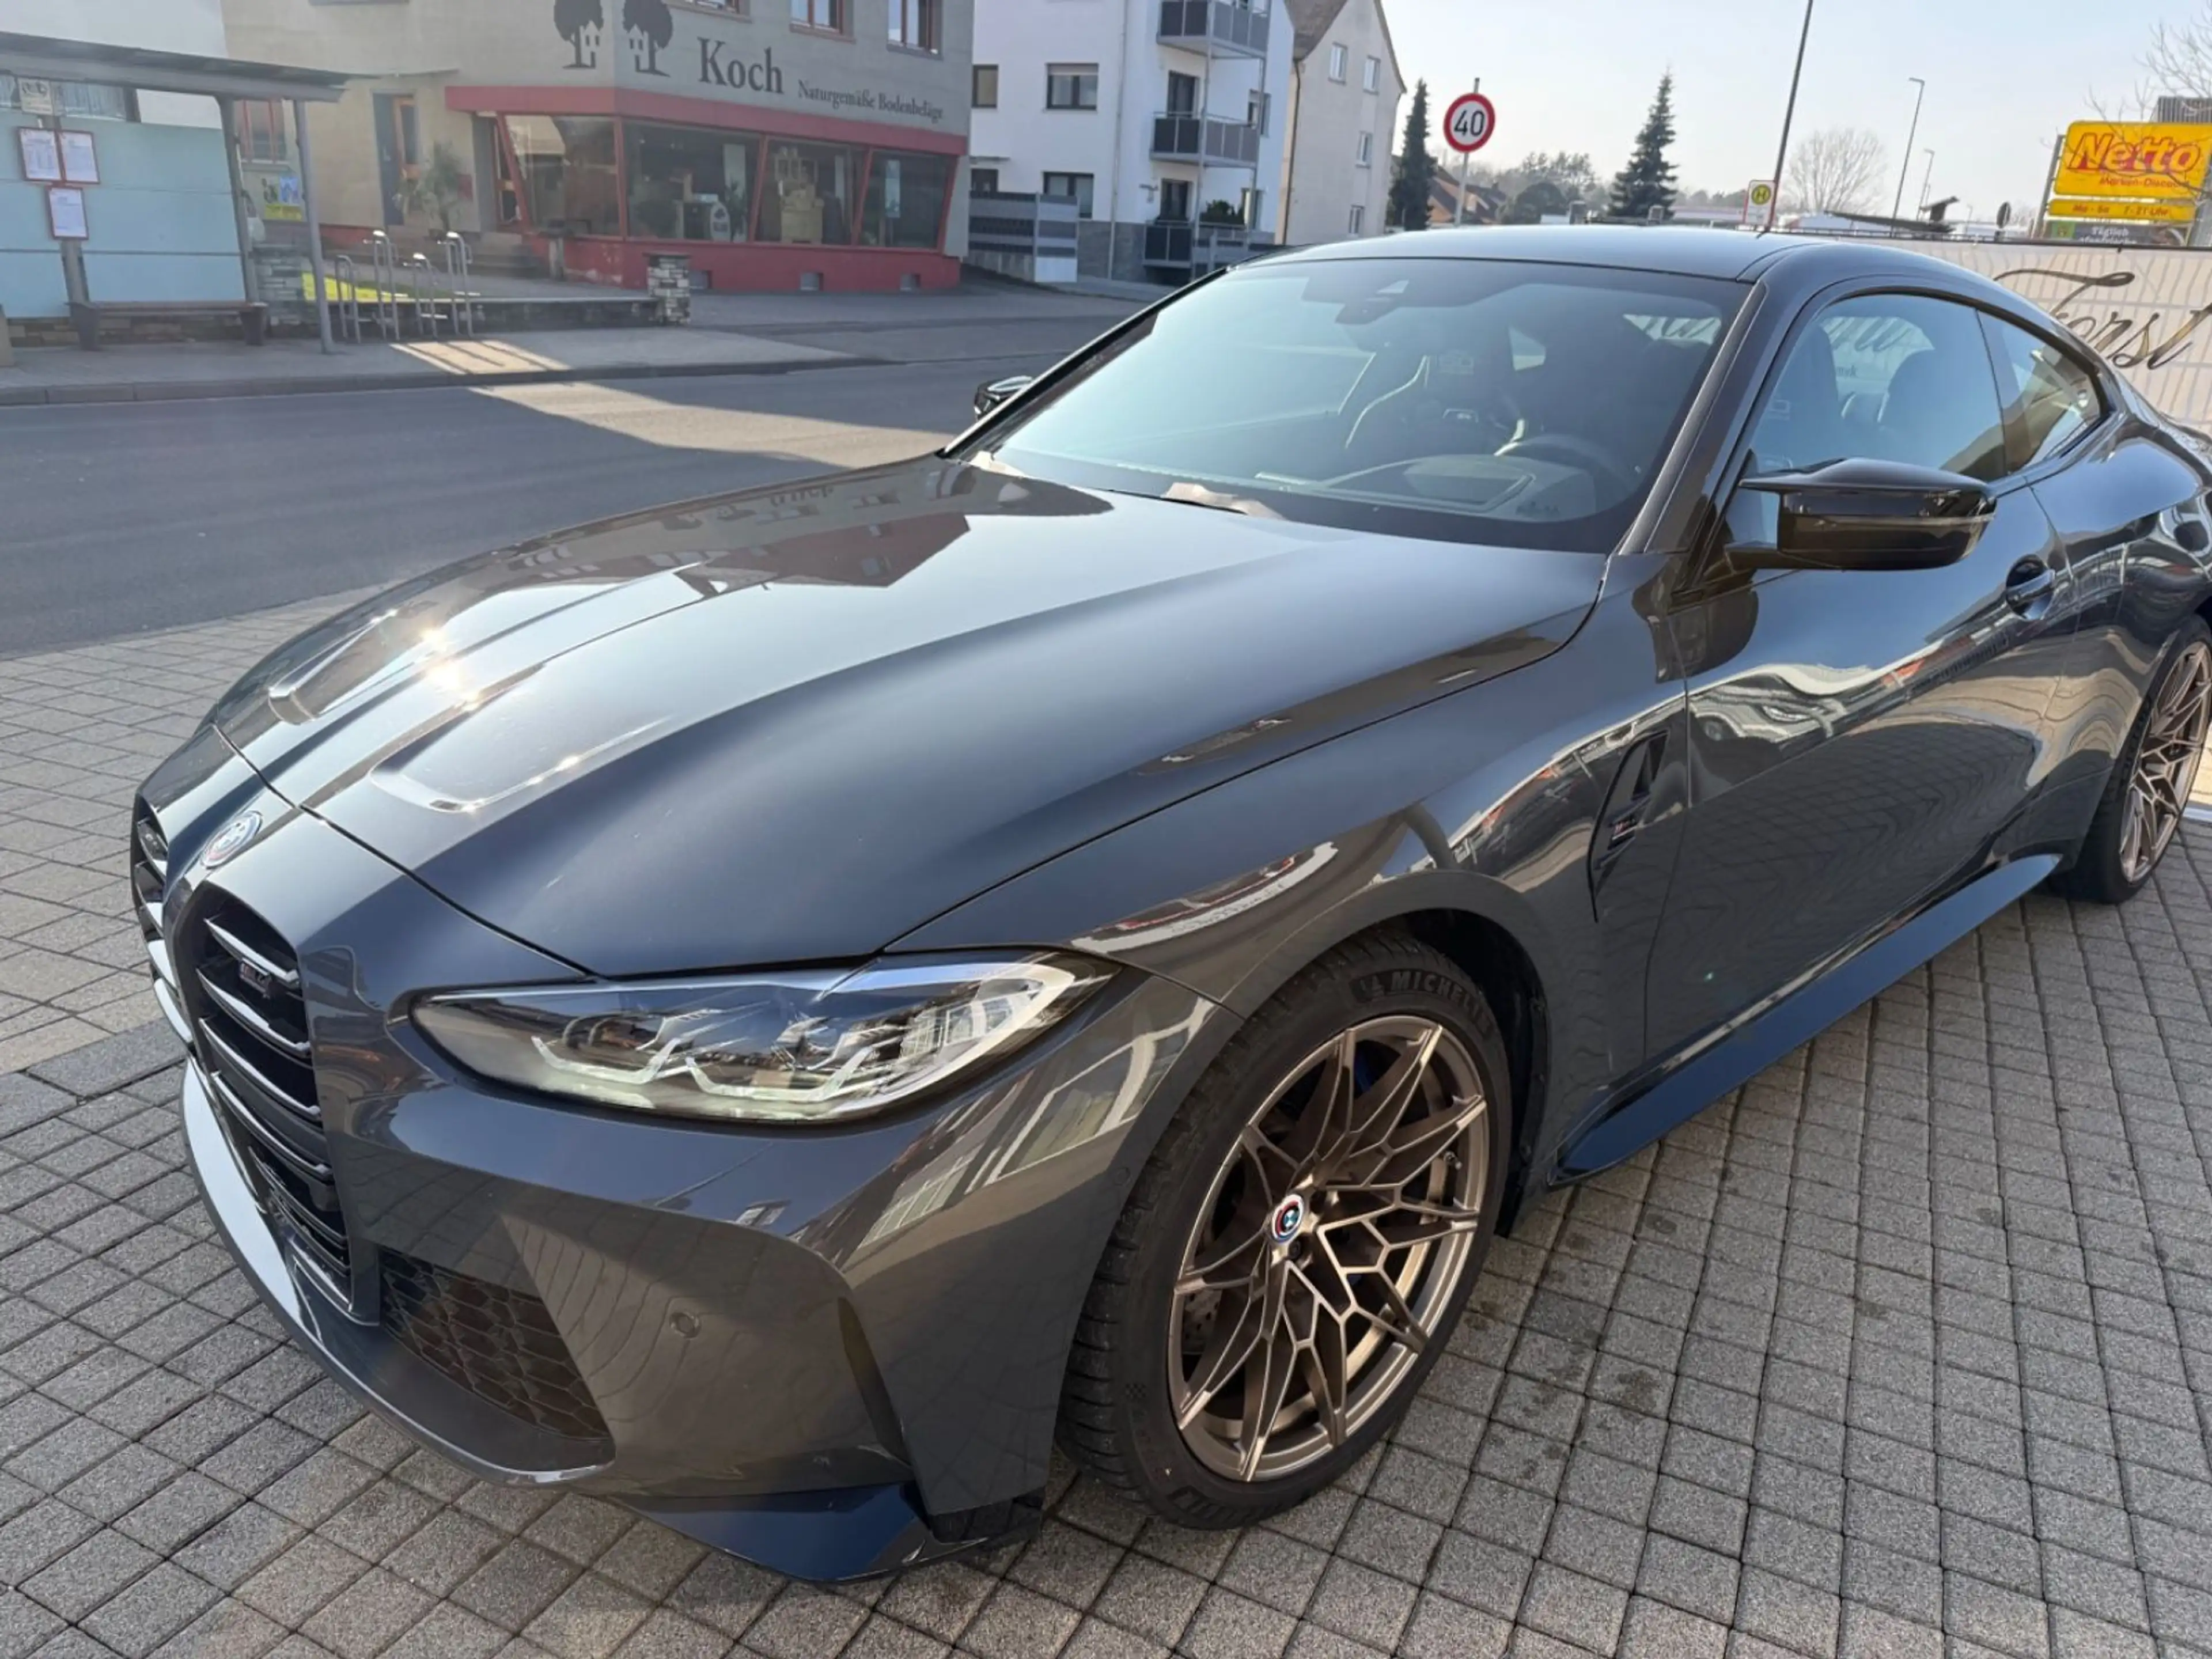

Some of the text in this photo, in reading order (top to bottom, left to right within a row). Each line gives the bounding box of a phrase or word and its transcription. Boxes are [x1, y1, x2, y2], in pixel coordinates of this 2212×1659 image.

[697, 36, 784, 95] Koch
[798, 79, 876, 109] Naturgemäße
[1454, 109, 1484, 137] 40
[2067, 132, 2200, 177] Netto
